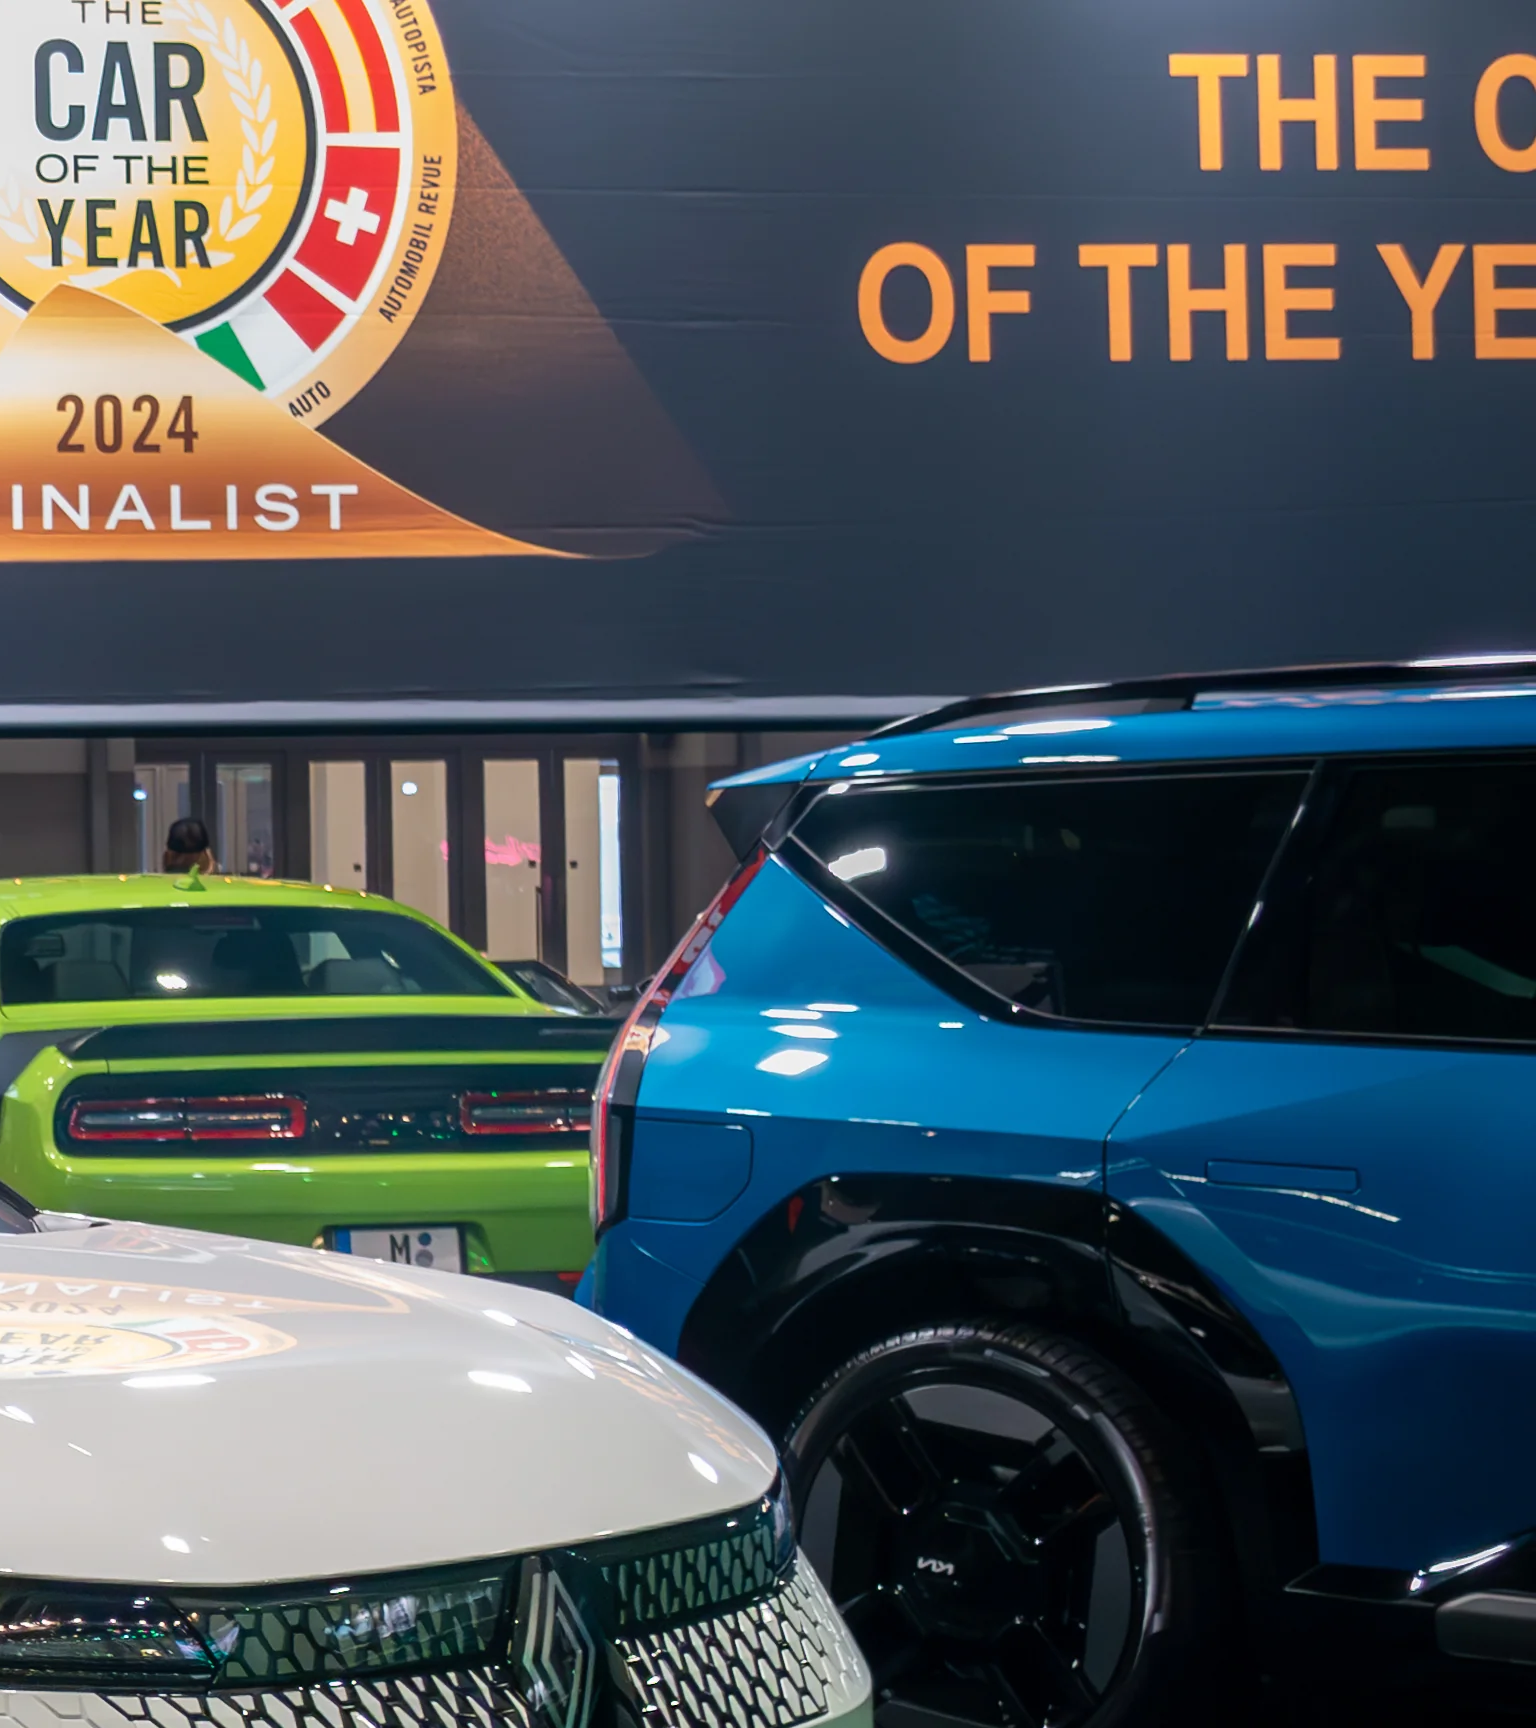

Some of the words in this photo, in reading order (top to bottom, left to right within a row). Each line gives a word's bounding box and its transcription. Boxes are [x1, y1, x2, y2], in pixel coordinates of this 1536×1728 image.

[71, 0, 164, 25] THE
[34, 38, 209, 142] CAR
[1169, 53, 1430, 171] THE
[35, 154, 99, 183] OF
[113, 155, 209, 184] THE
[37, 198, 212, 269] YEAR
[378, 223, 434, 324] AUTOMOBIL
[418, 155, 442, 215] REVUE
[858, 241, 1036, 363] OF
[1078, 243, 1341, 361] THE
[56, 394, 199, 454] 2024
[288, 380, 331, 418] AUTO
[389, 1233, 412, 1265] M
